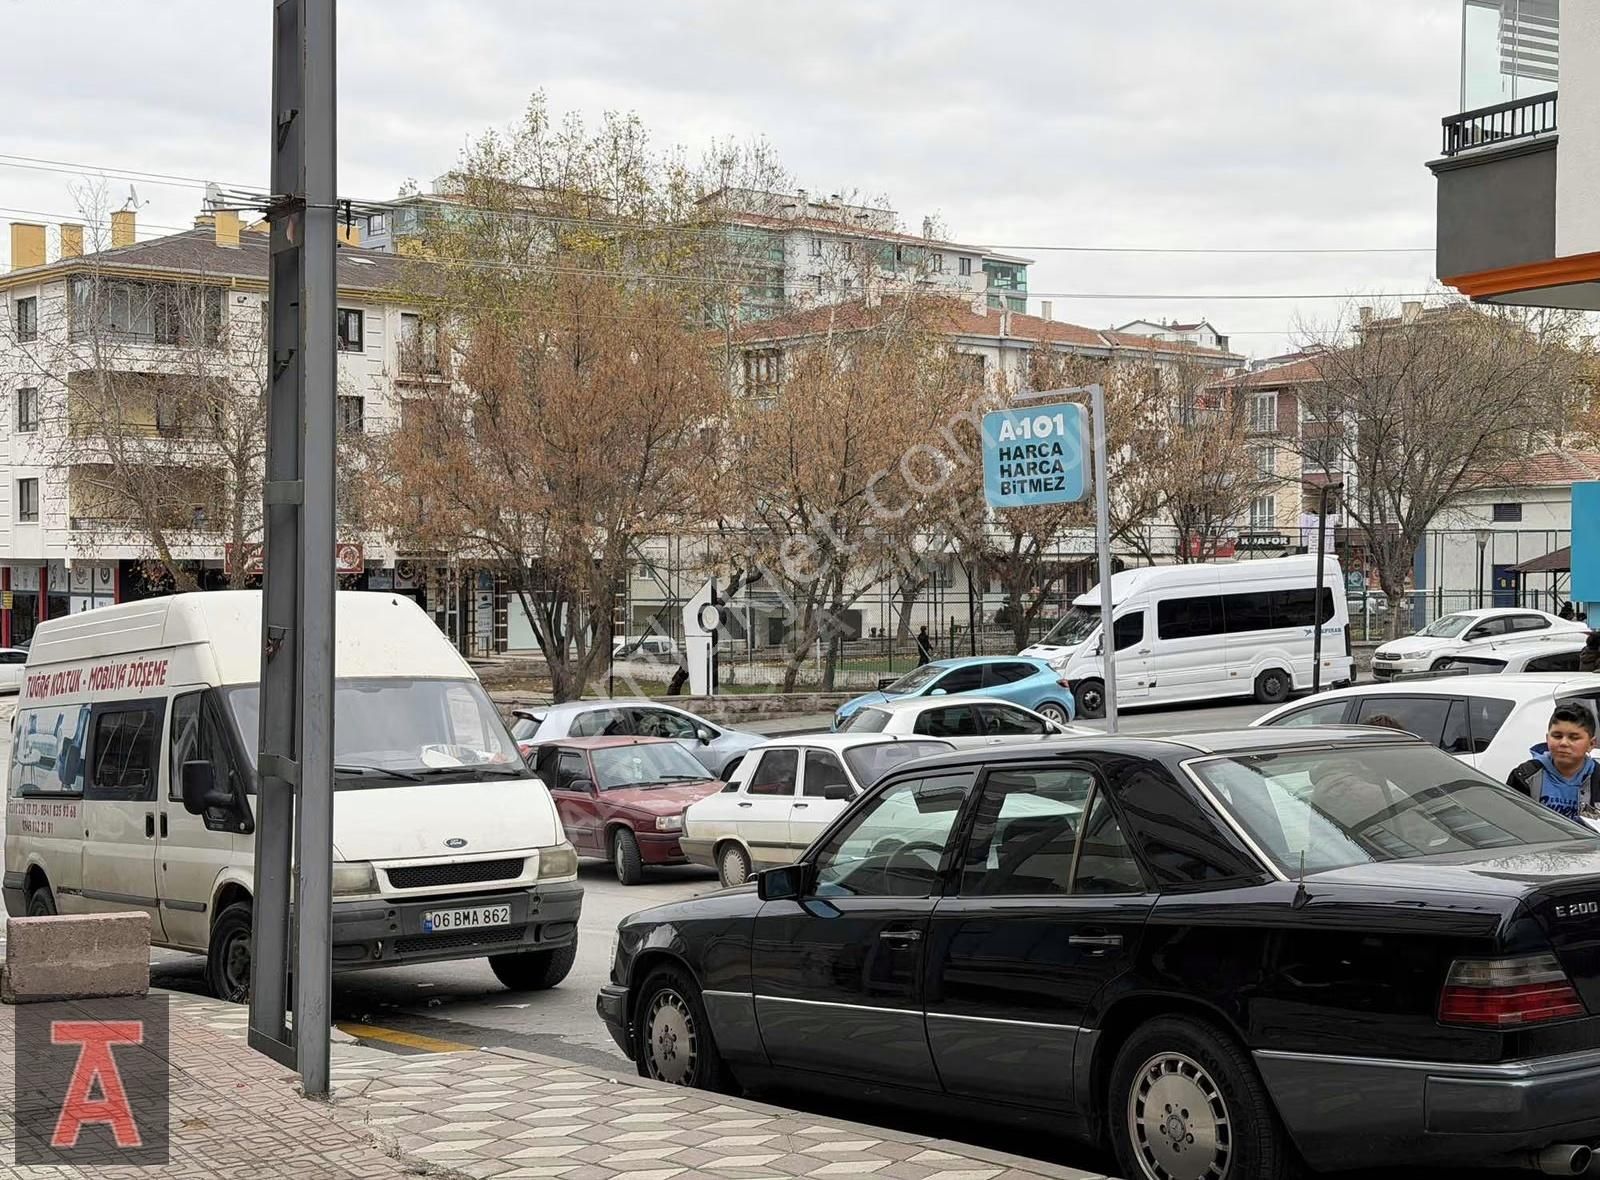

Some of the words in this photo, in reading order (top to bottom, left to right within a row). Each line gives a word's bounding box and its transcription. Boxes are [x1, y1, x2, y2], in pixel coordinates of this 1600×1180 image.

[999, 442, 1063, 461] HARCA
[1000, 459, 1064, 478] HARCA
[50, 669, 83, 696] KOLTUK
[88, 660, 128, 692] MOBİLYA
[127, 656, 168, 694] DÖŞEME
[433, 913, 450, 928] 06
[454, 910, 479, 926] BMA
[483, 908, 508, 923] 862
[1556, 905, 1567, 917] E
[1569, 902, 1598, 916] 200
